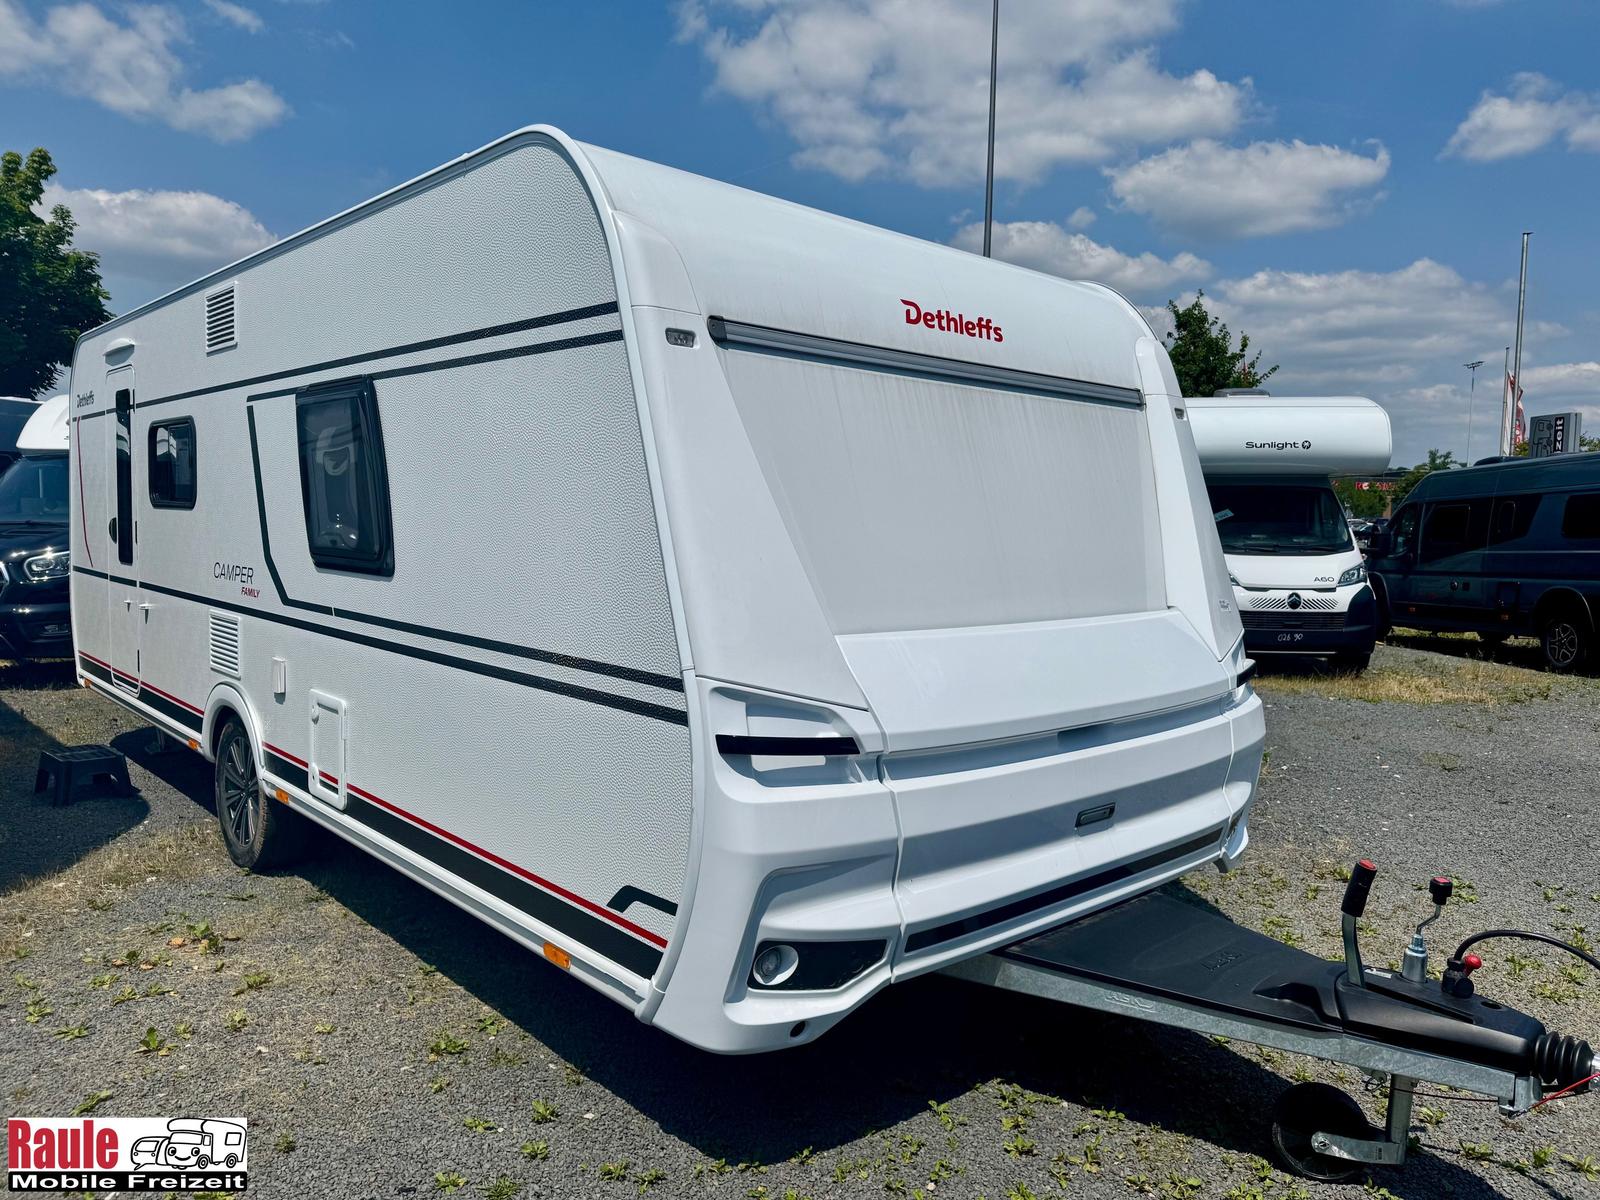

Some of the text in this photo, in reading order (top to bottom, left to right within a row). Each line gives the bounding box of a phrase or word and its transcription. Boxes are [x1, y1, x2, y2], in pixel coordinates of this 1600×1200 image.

[900, 299, 1003, 342] Dethleffs
[1245, 441, 1299, 450] Sunlight
[213, 562, 254, 584] CAMPER
[240, 586, 260, 598] FAMILY
